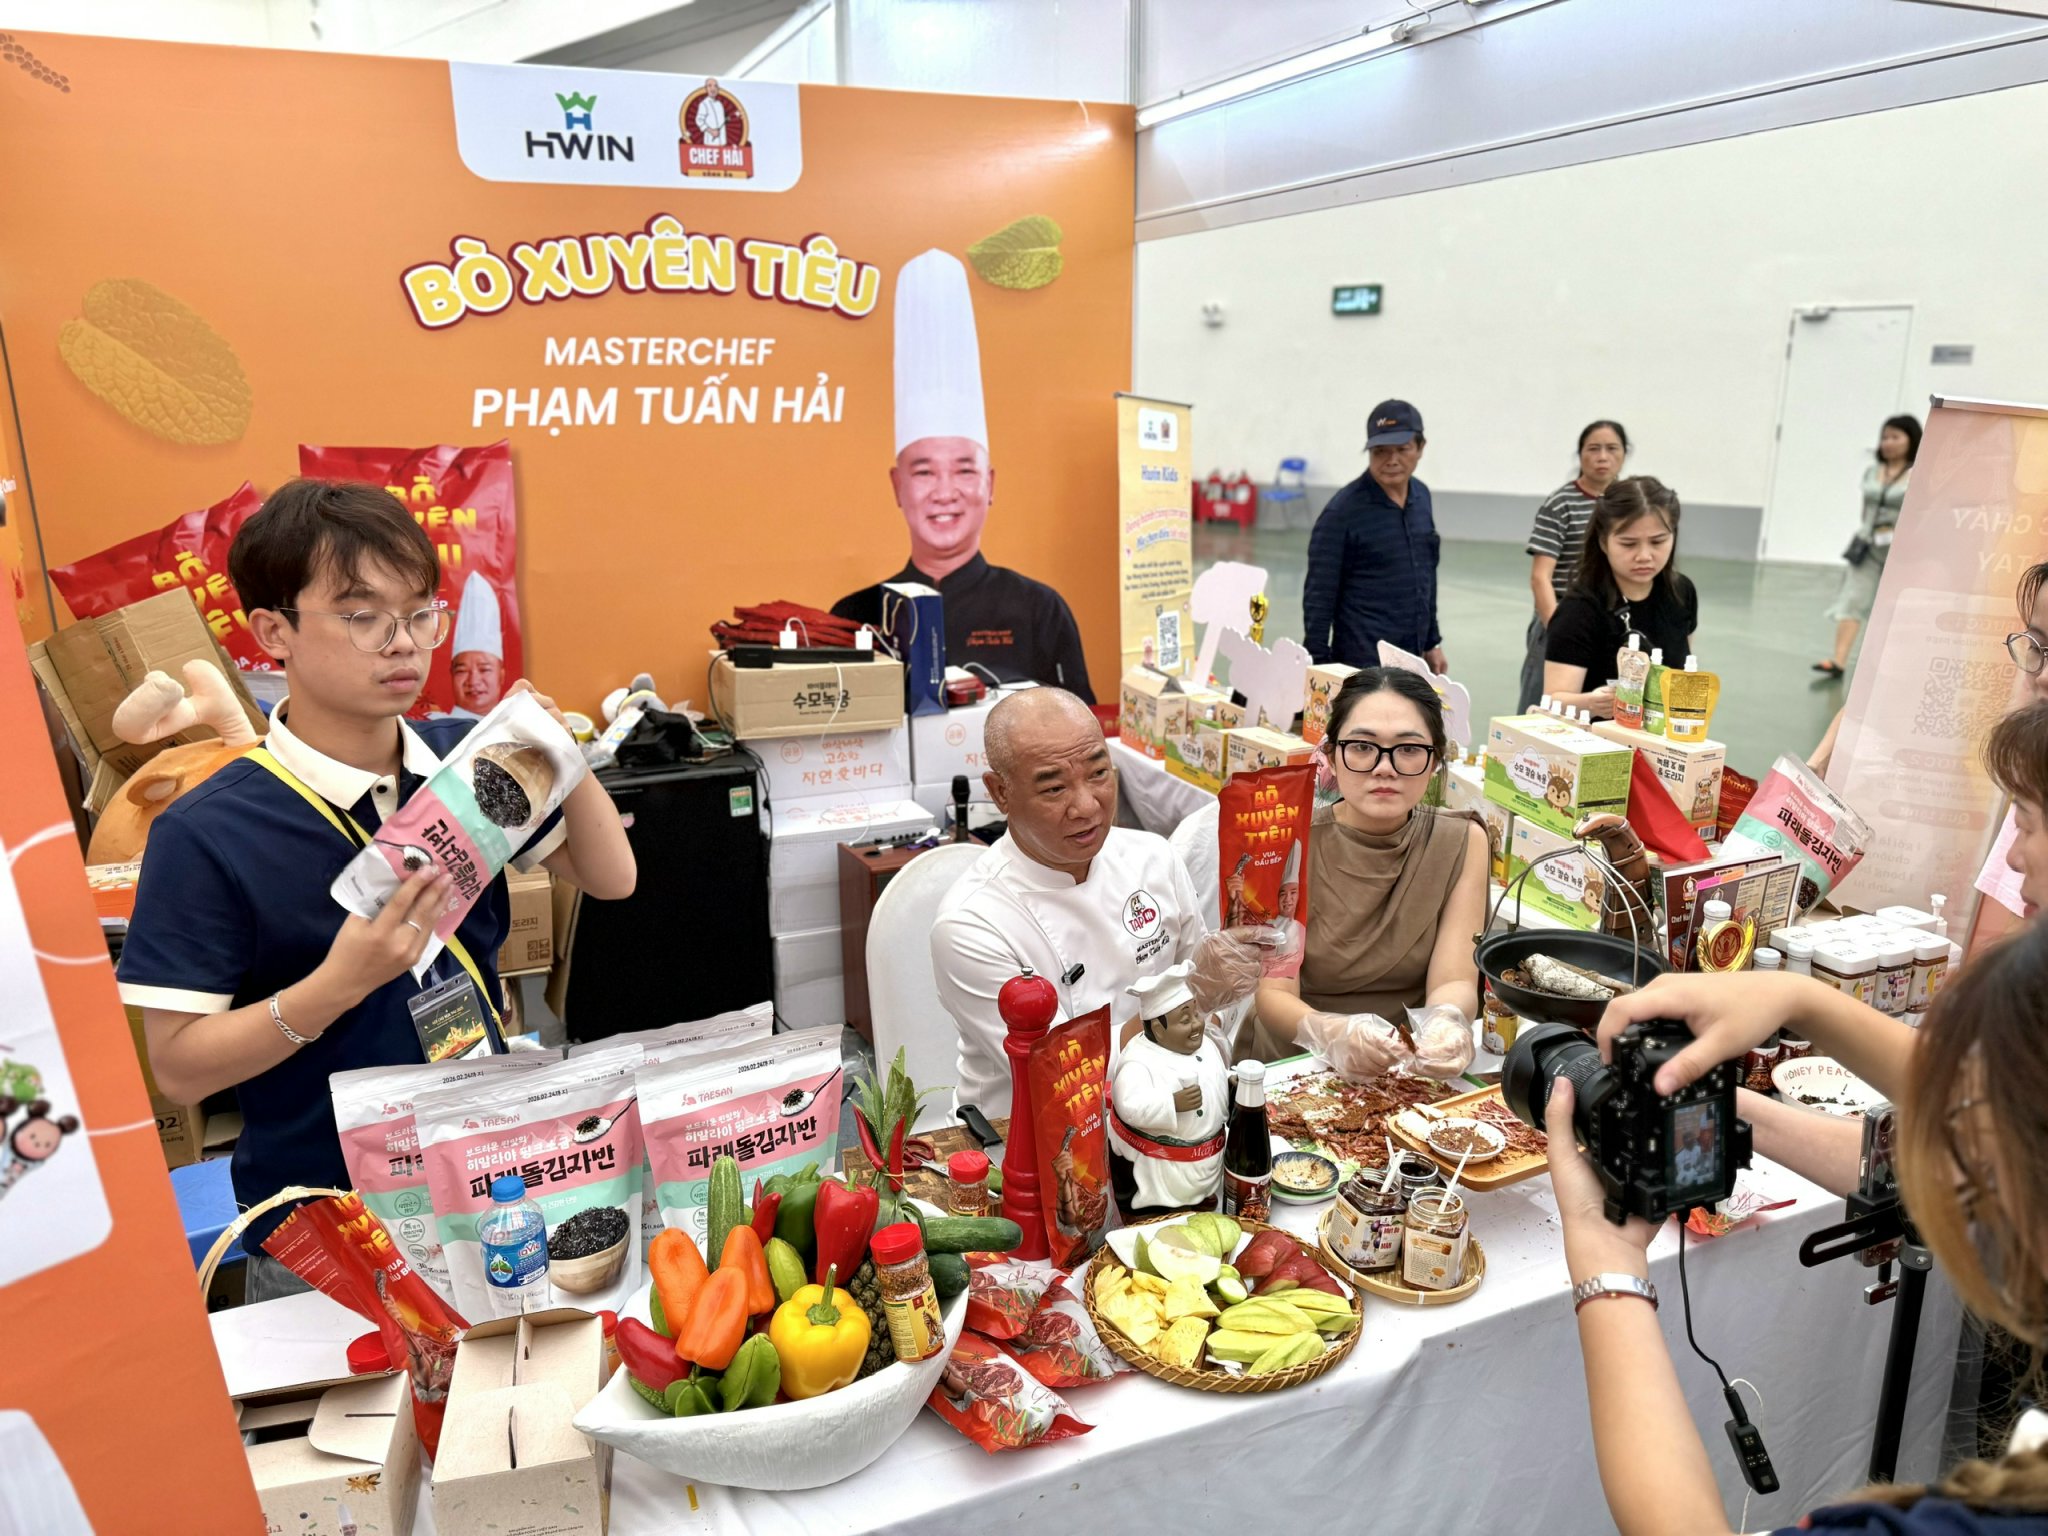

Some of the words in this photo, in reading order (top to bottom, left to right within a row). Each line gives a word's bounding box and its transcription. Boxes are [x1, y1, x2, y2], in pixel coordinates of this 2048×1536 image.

[525, 131, 635, 162] HWIN
[689, 147, 720, 165] CHEF
[722, 144, 744, 166] HẢI
[401, 235, 513, 329] BÒ
[509, 214, 737, 303] XUYÊN
[738, 233, 881, 320] TIÊU
[544, 337, 776, 366] MASTERCHEF
[472, 387, 619, 436] PHẠM
[634, 374, 758, 424] TUẤN
[772, 372, 845, 424] HẢI
[431, 596, 448, 608] ẾP
[1254, 785, 1279, 807] BÒ
[1236, 803, 1299, 828] XUYÊN
[1244, 825, 1292, 847] TIÊU
[1777, 807, 1842, 874] 파래돌김자반
[1058, 1039, 1082, 1070] BÒ
[1053, 1054, 1106, 1098] XUYÊN
[1783, 1066, 1812, 1082] HONEY
[1818, 1065, 1857, 1079] PEAC
[698, 1086, 733, 1103] TAESAN
[482, 1113, 521, 1128] TAESAN
[1085, 1113, 1097, 1125] VUA
[467, 1151, 517, 1171] 히말라야
[520, 1135, 571, 1159] 핑크소금
